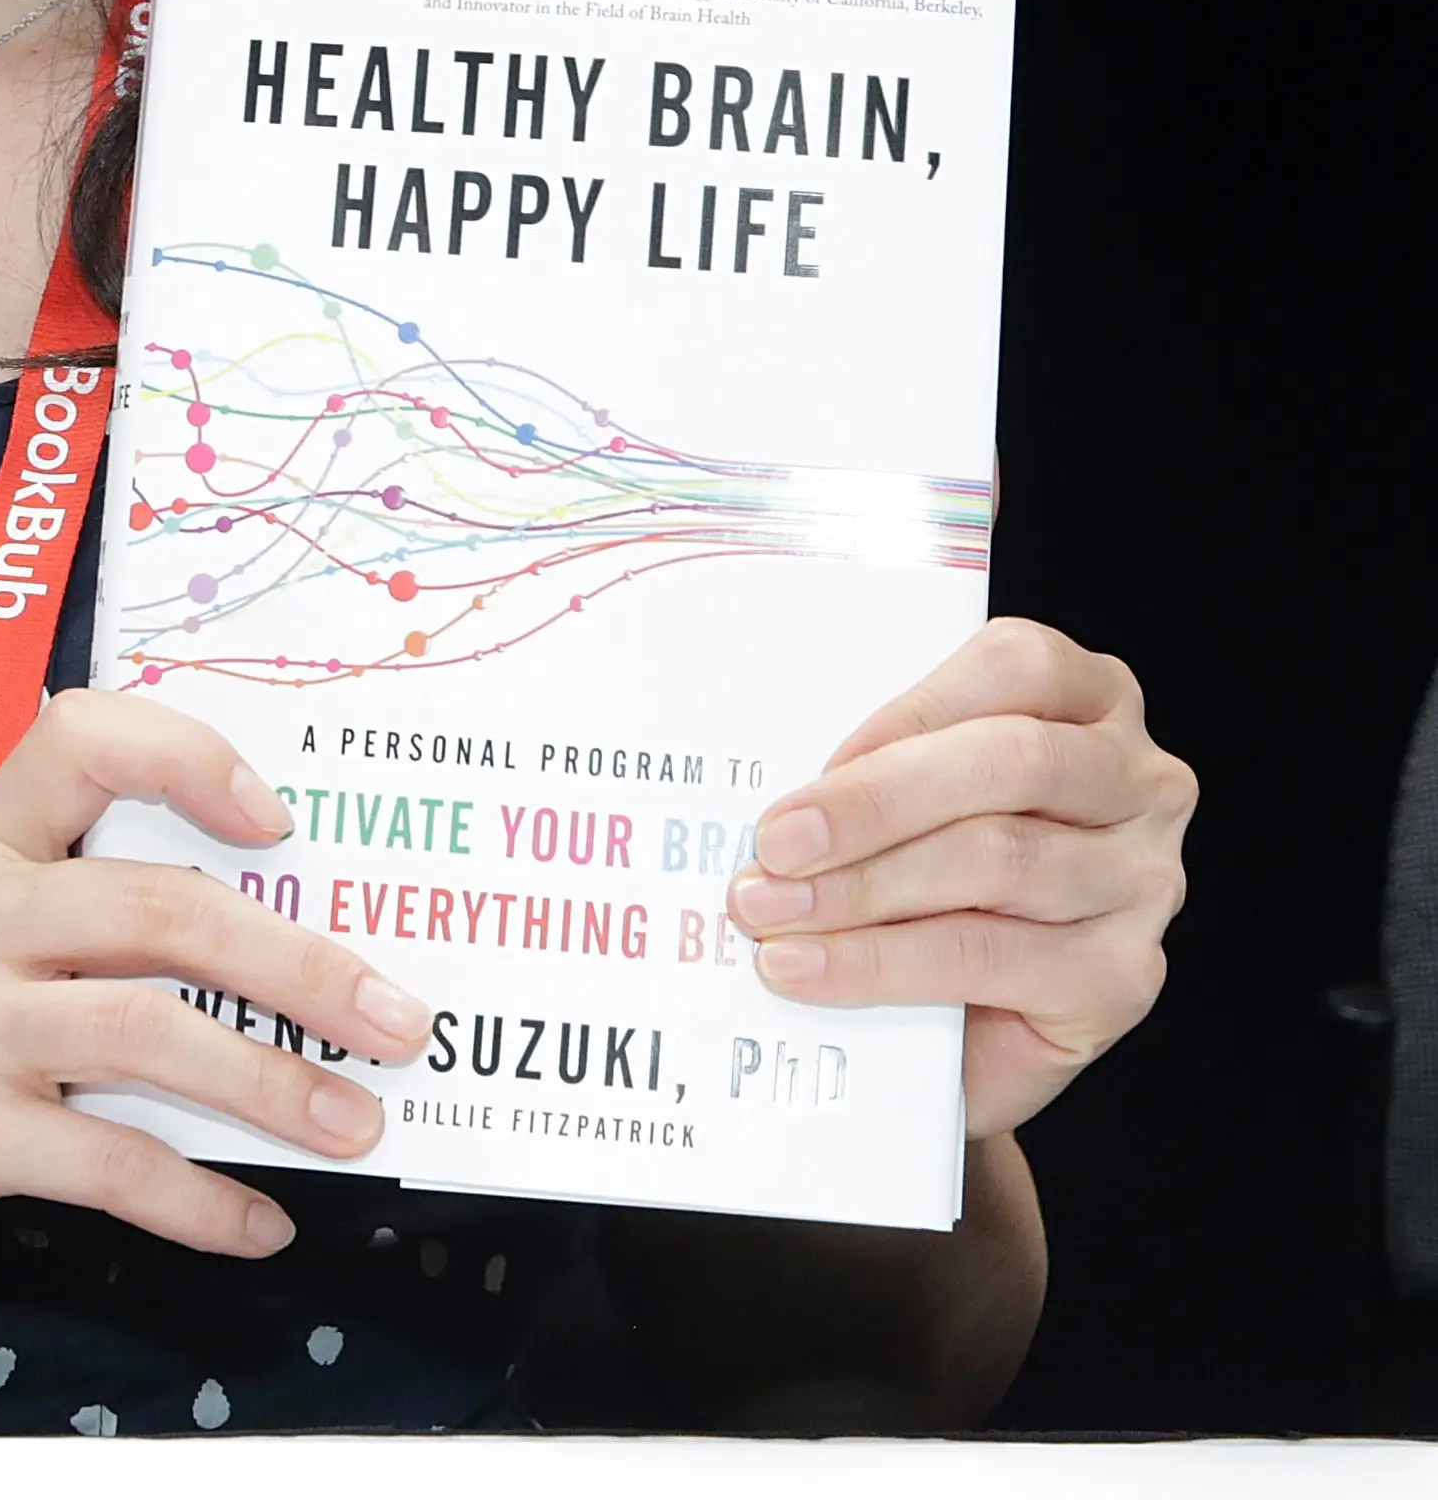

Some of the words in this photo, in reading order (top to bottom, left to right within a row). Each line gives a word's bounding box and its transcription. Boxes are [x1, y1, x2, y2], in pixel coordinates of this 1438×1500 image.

[536, 1, 550, 14] in
[556, 1, 580, 16] the
[586, 2, 624, 18] Field
[629, 5, 648, 20] of
[651, 5, 691, 22] Brain
[698, 8, 750, 25] Health
[243, 40, 606, 142] HEALTHY
[649, 61, 940, 180] BRAIN,
[332, 163, 604, 263] HAPPY
[648, 182, 824, 277] LIFE
[302, 725, 315, 753] A
[341, 728, 515, 769] PERSONAL
[541, 744, 702, 784] PROGRAM
[727, 758, 763, 790] TO
[501, 805, 632, 868] YOUR
[329, 879, 647, 959] EVERYTHING
[428, 1010, 686, 1101] SUZUKI,
[730, 1037, 848, 1102] PhD
[403, 1099, 492, 1129] BILLIE
[513, 1109, 694, 1148] FITZPATRICK
